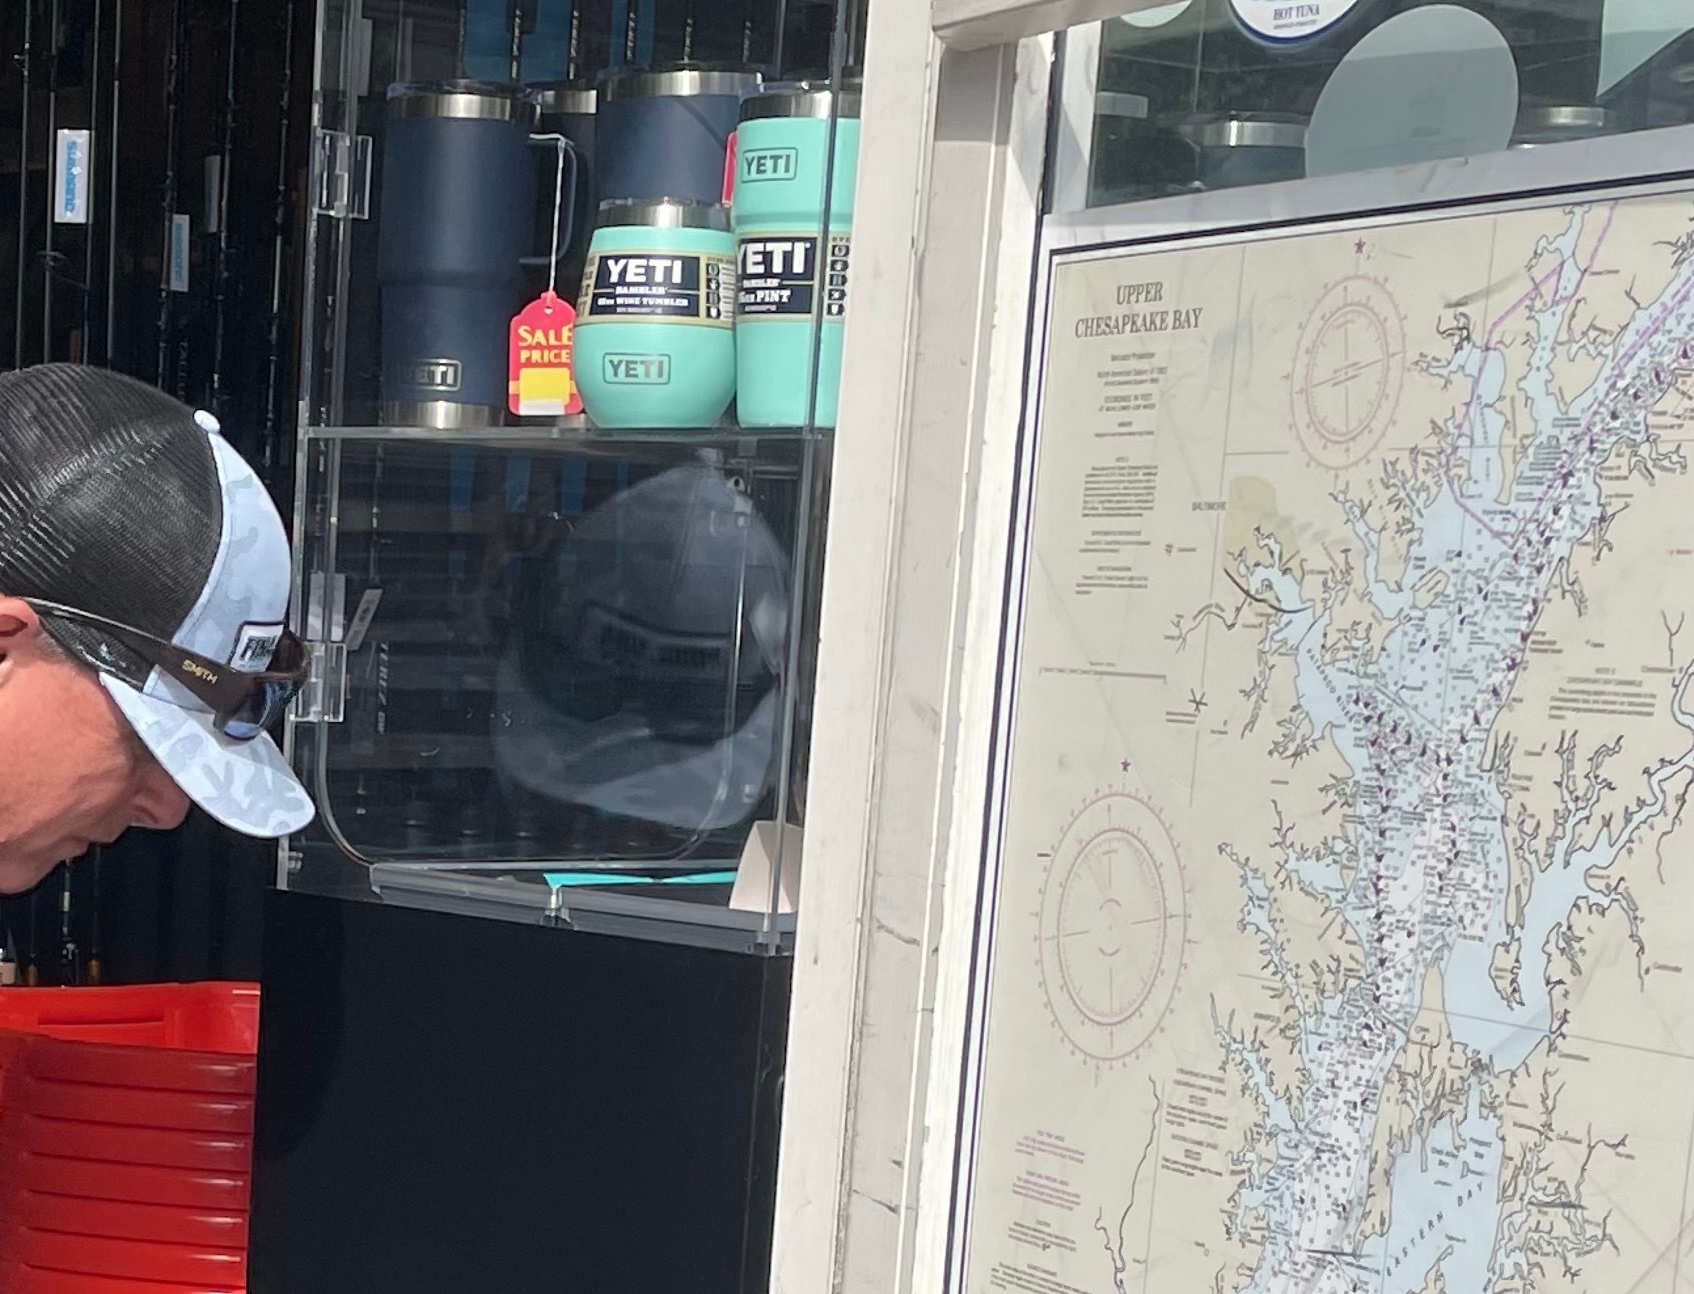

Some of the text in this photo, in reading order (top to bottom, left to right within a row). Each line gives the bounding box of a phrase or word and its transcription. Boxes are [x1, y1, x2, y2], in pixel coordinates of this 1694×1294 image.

[745, 154, 791, 176] YETI
[607, 258, 682, 284] YETI
[756, 289, 792, 303] PINT
[1116, 281, 1164, 306] UPPER
[518, 323, 573, 347] SALE
[1075, 308, 1203, 338] CHESAPEAKE BAY
[520, 349, 571, 364] PRICE
[608, 359, 664, 379] YETI
[181, 658, 219, 685] SMITH
